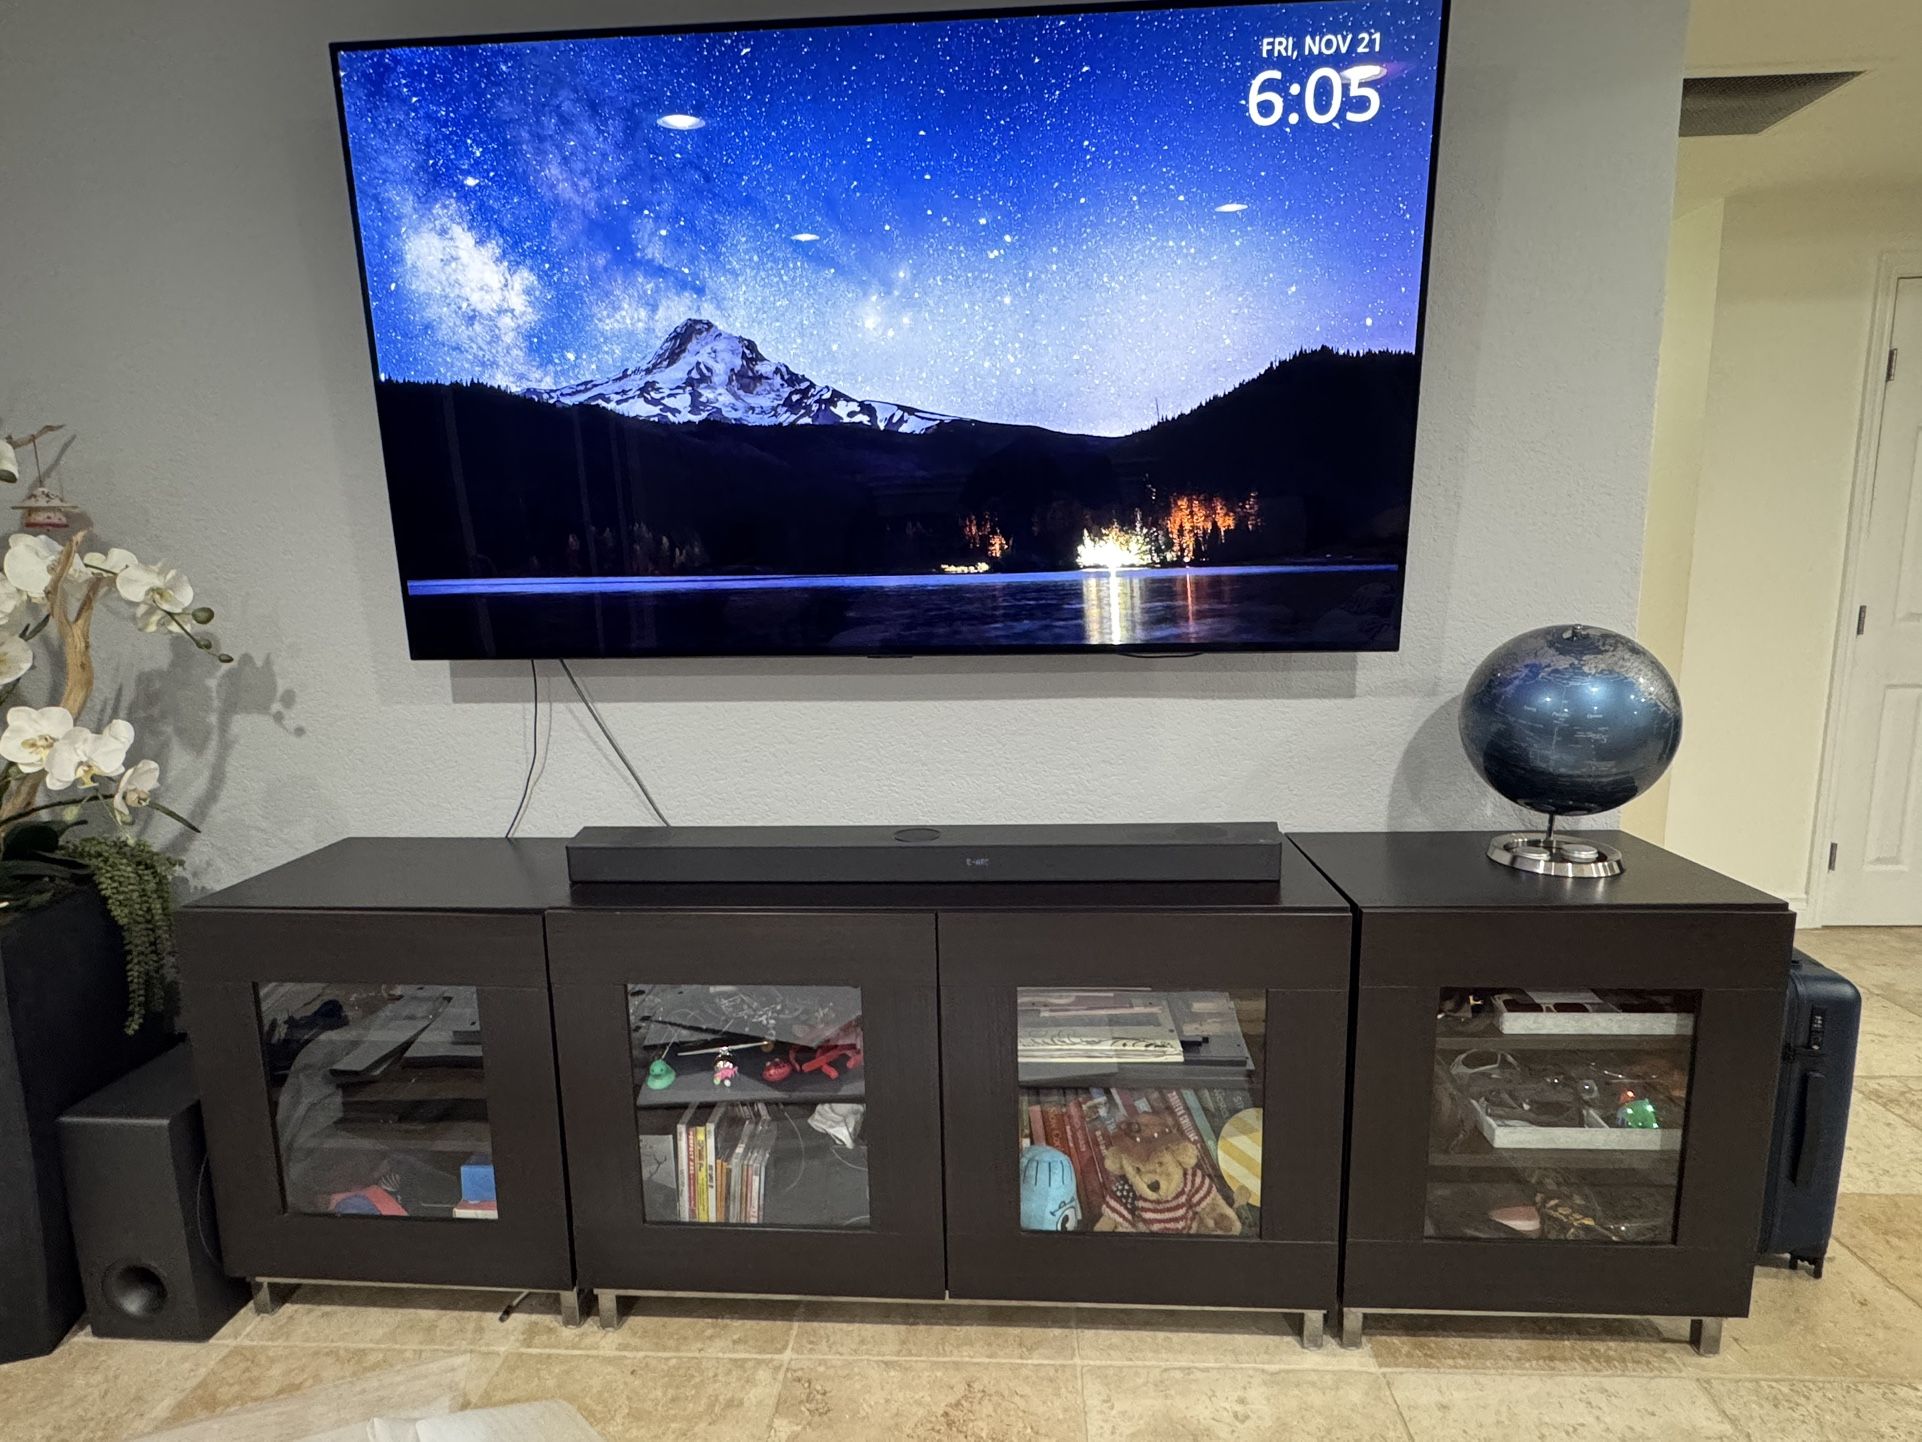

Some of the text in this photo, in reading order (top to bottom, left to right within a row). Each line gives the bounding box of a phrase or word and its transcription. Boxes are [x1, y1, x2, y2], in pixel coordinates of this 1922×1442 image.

[1262, 31, 1381, 60] FRI, NOV 21
[1248, 65, 1381, 127] 6:05
